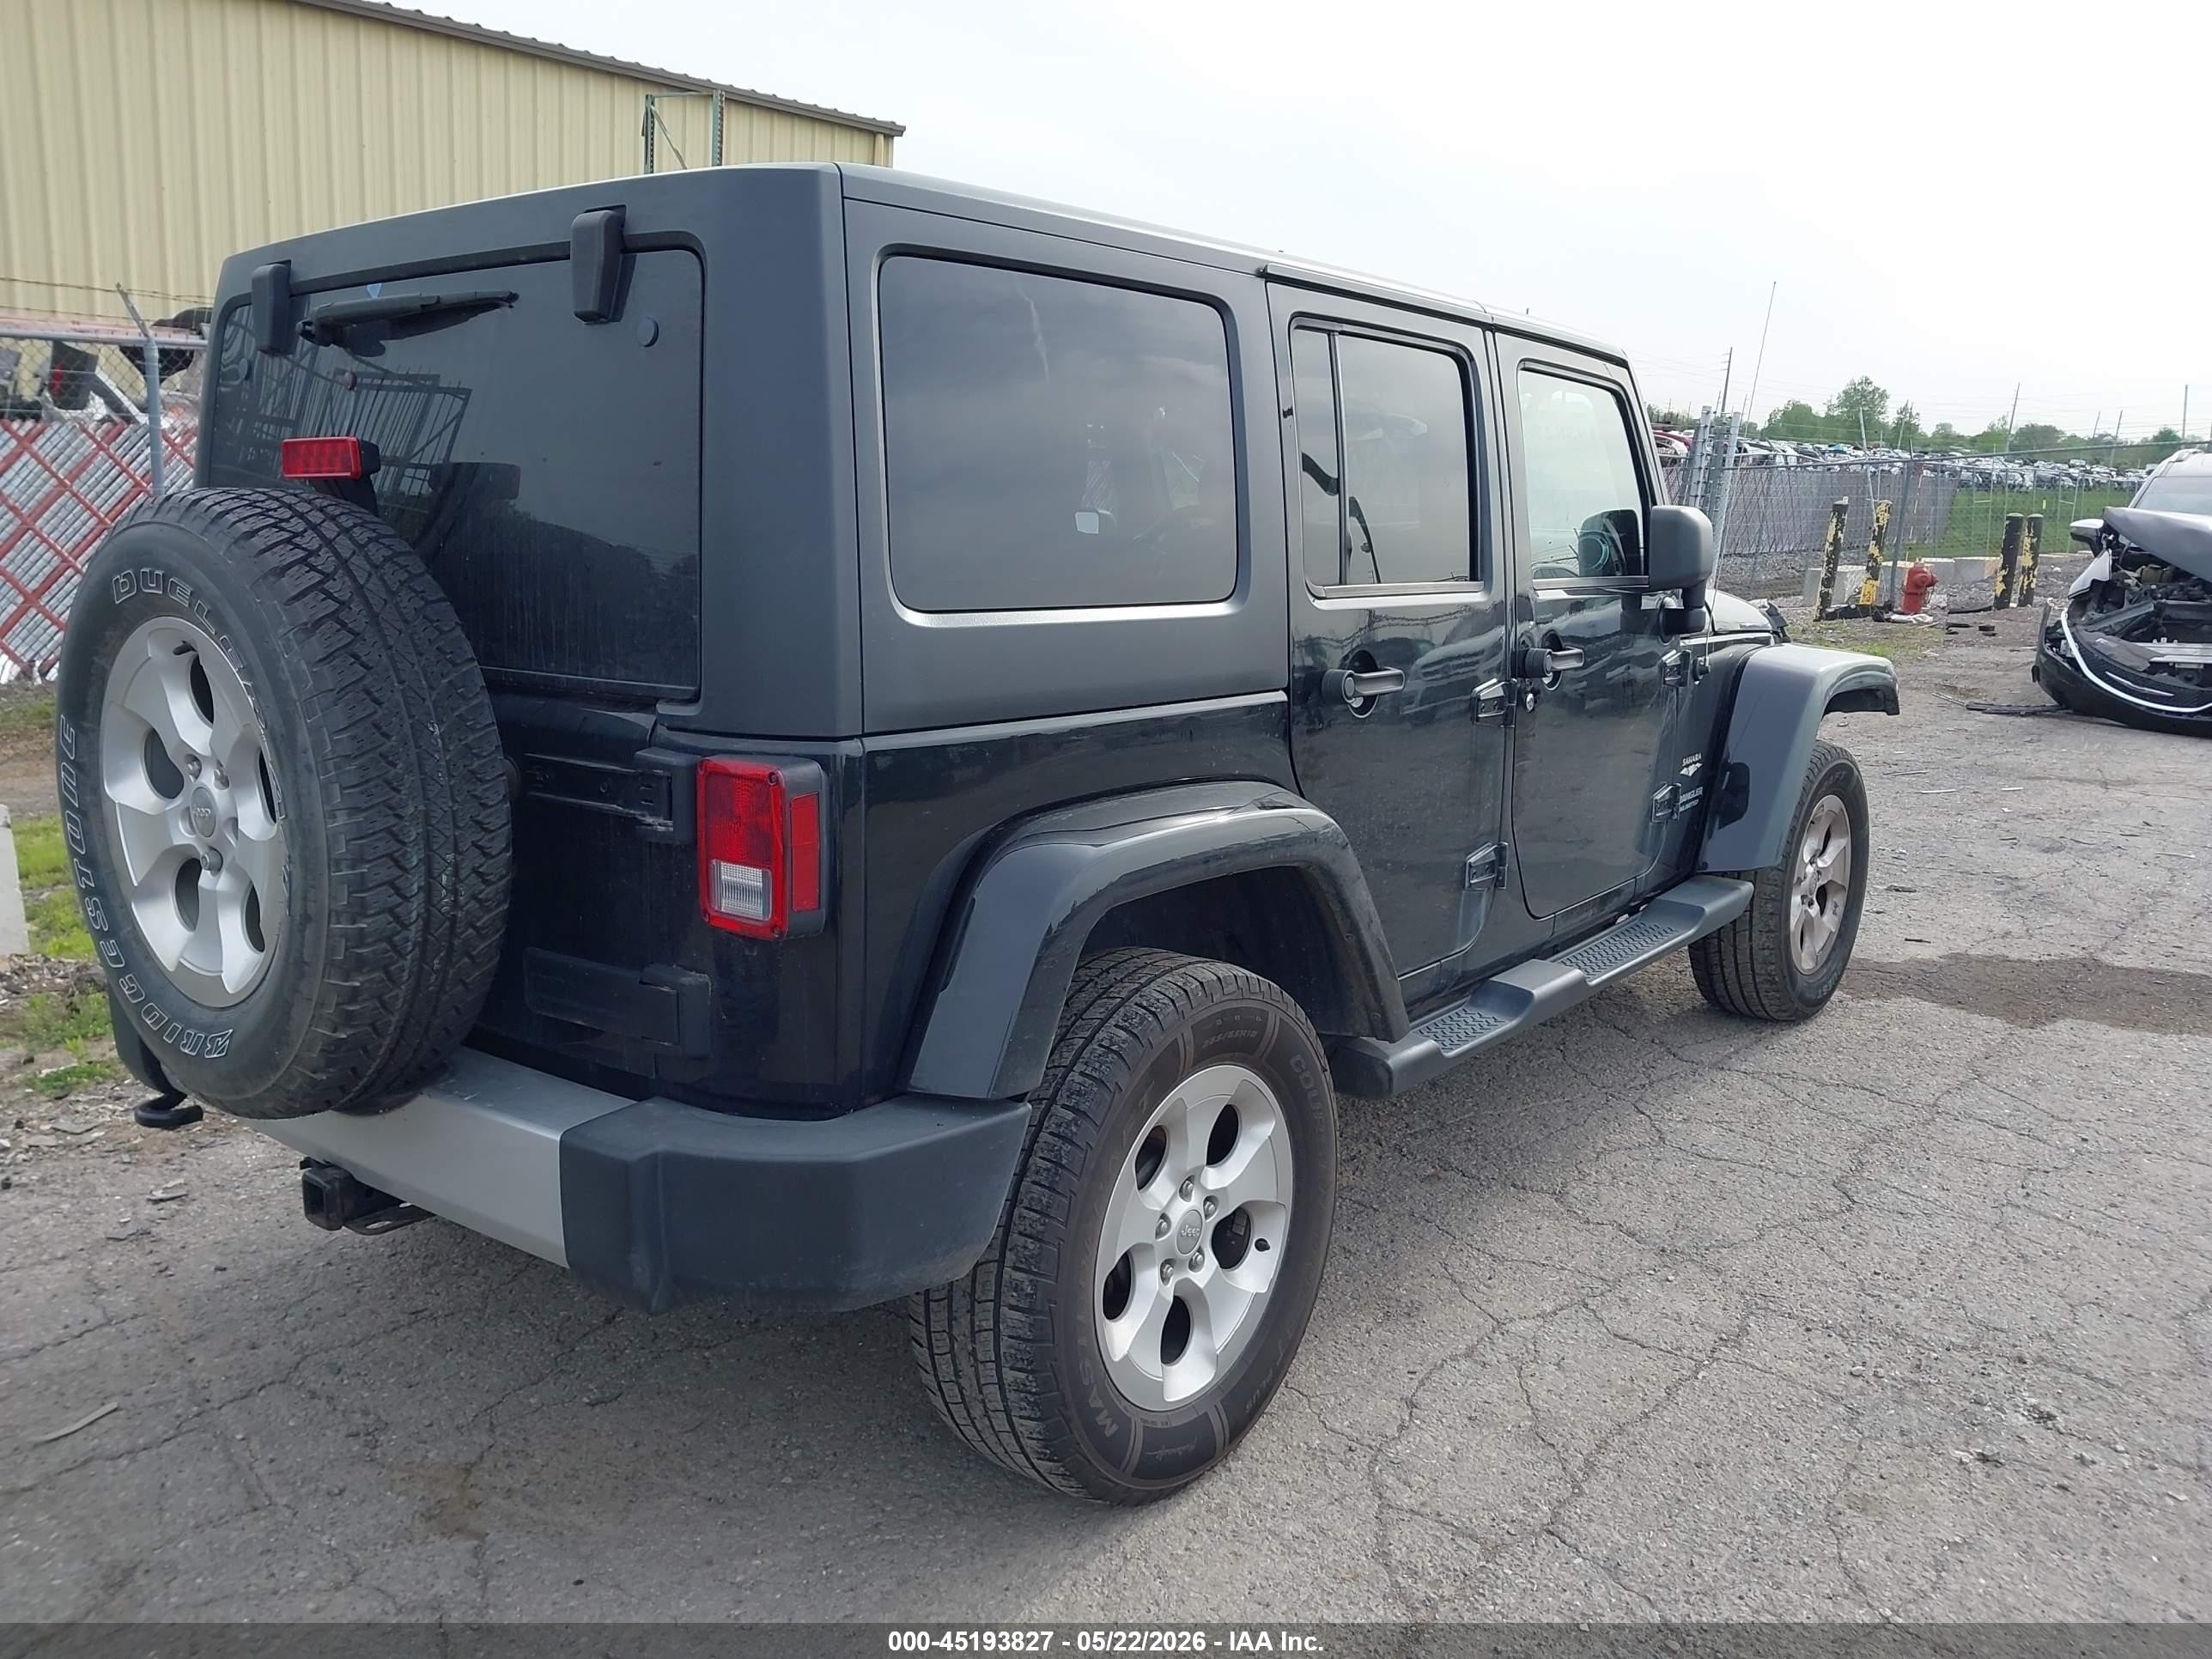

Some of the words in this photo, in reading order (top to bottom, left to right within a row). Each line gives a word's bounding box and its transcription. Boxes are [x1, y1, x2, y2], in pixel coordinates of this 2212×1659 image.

[1682, 752, 1703, 767] SAHARA
[60, 714, 233, 1060] BRIDGESTONE
[1181, 1224, 1200, 1237] Jeep
